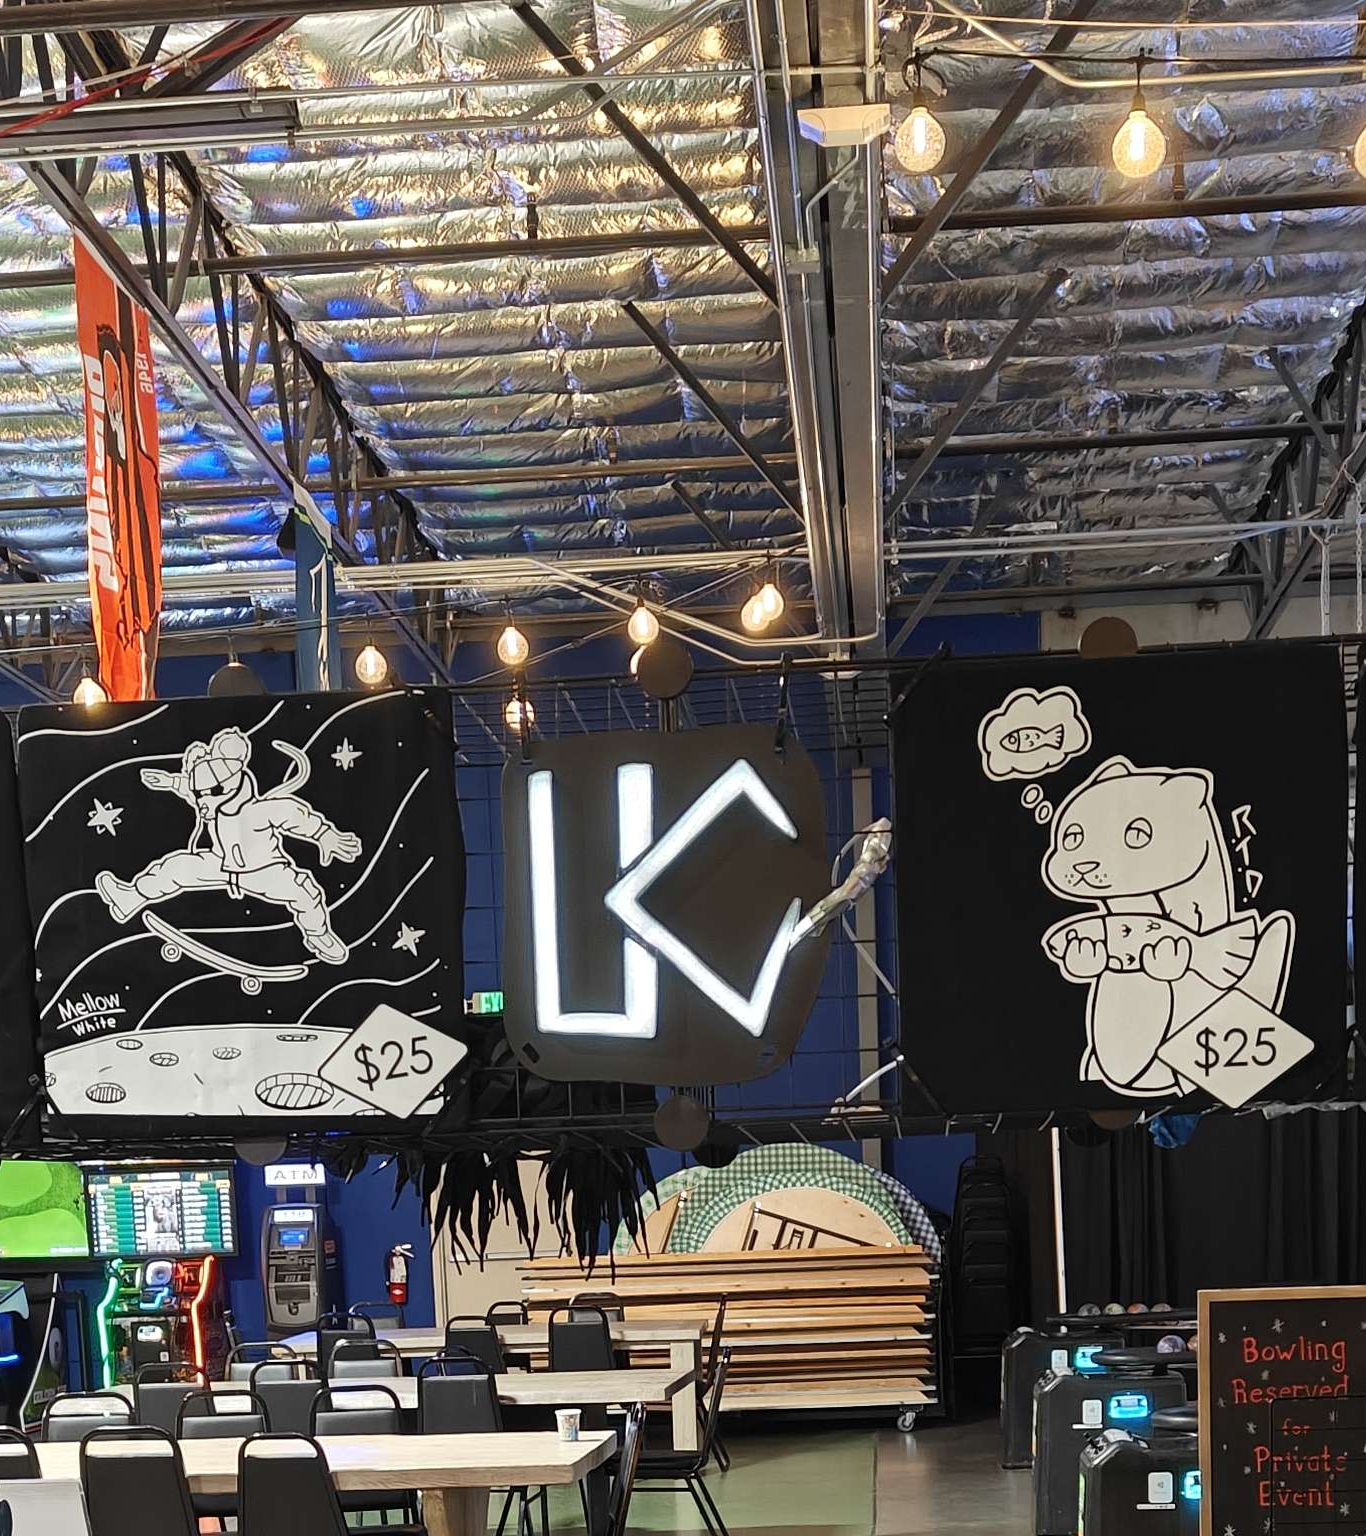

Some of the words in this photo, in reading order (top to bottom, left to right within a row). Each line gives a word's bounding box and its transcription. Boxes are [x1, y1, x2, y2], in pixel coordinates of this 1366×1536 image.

[57, 992, 120, 1022] Mellow
[73, 1015, 117, 1036] White
[354, 1036, 434, 1091] $25
[1195, 1026, 1277, 1076] $25
[274, 1169, 318, 1180] ATM
[1243, 1336, 1346, 1373] Bowling
[1231, 1374, 1350, 1404] Reserved
[1281, 1417, 1312, 1436] for
[1253, 1445, 1348, 1473] Private
[1259, 1480, 1336, 1507] Event
